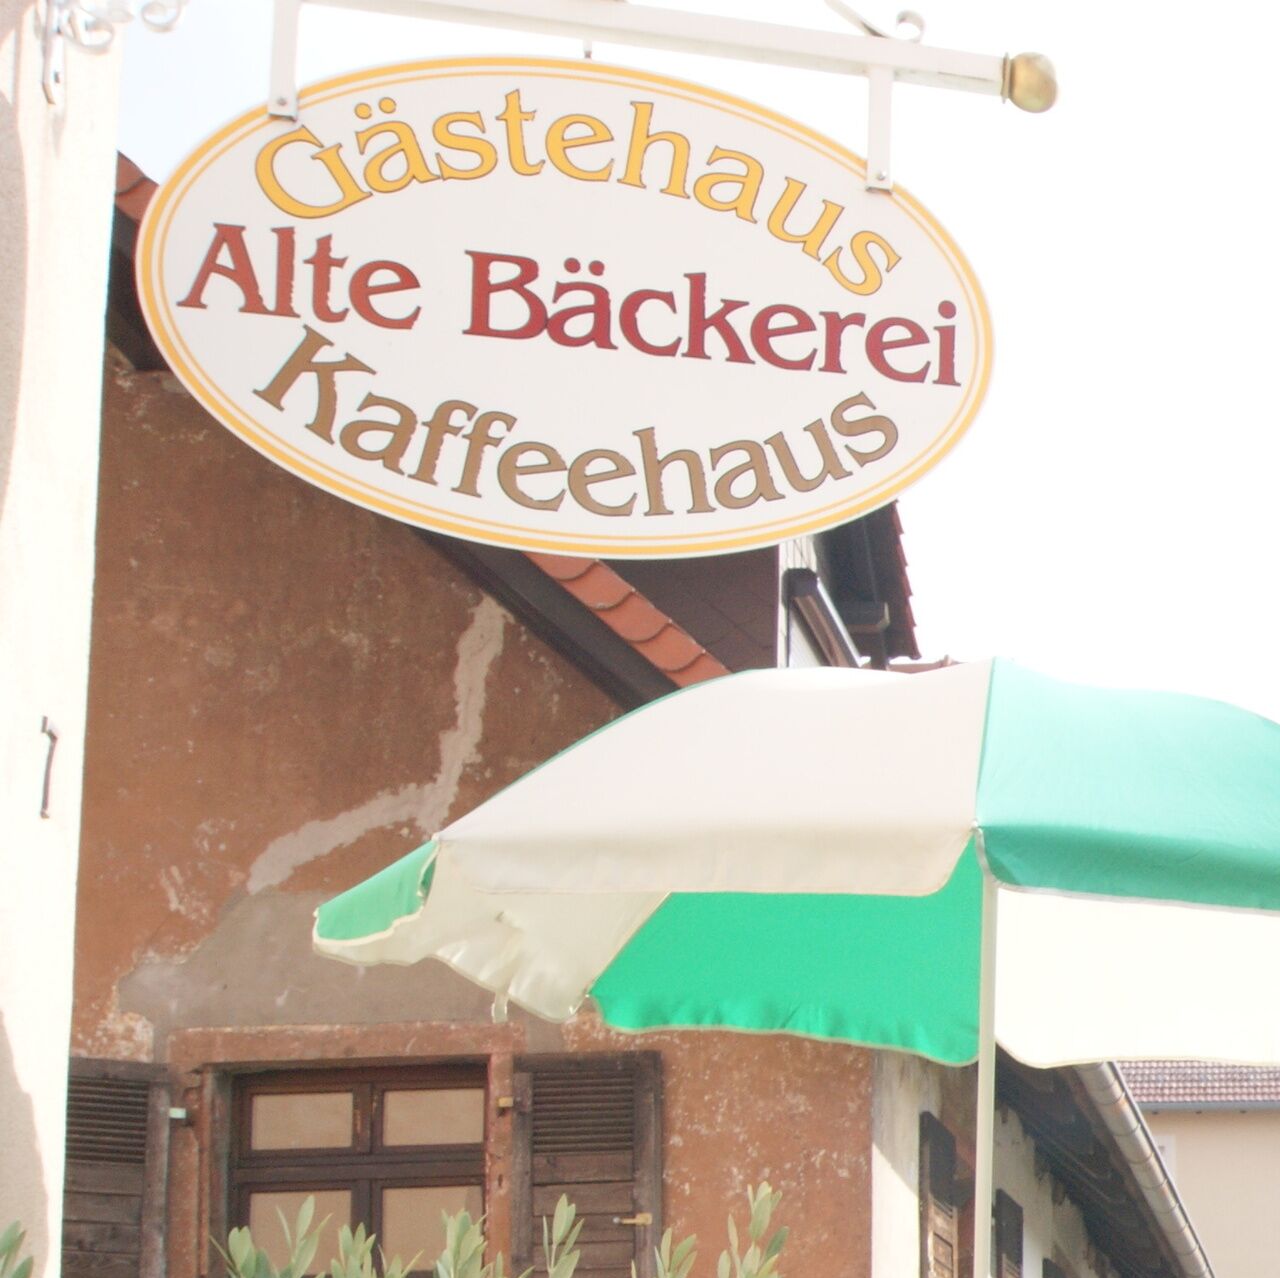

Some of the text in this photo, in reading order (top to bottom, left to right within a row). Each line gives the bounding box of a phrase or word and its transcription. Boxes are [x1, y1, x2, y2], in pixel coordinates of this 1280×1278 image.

[254, 89, 902, 298] Gästehaus
[176, 223, 962, 387] Alte Bäckerei
[253, 324, 900, 518] Kaffeehaus
